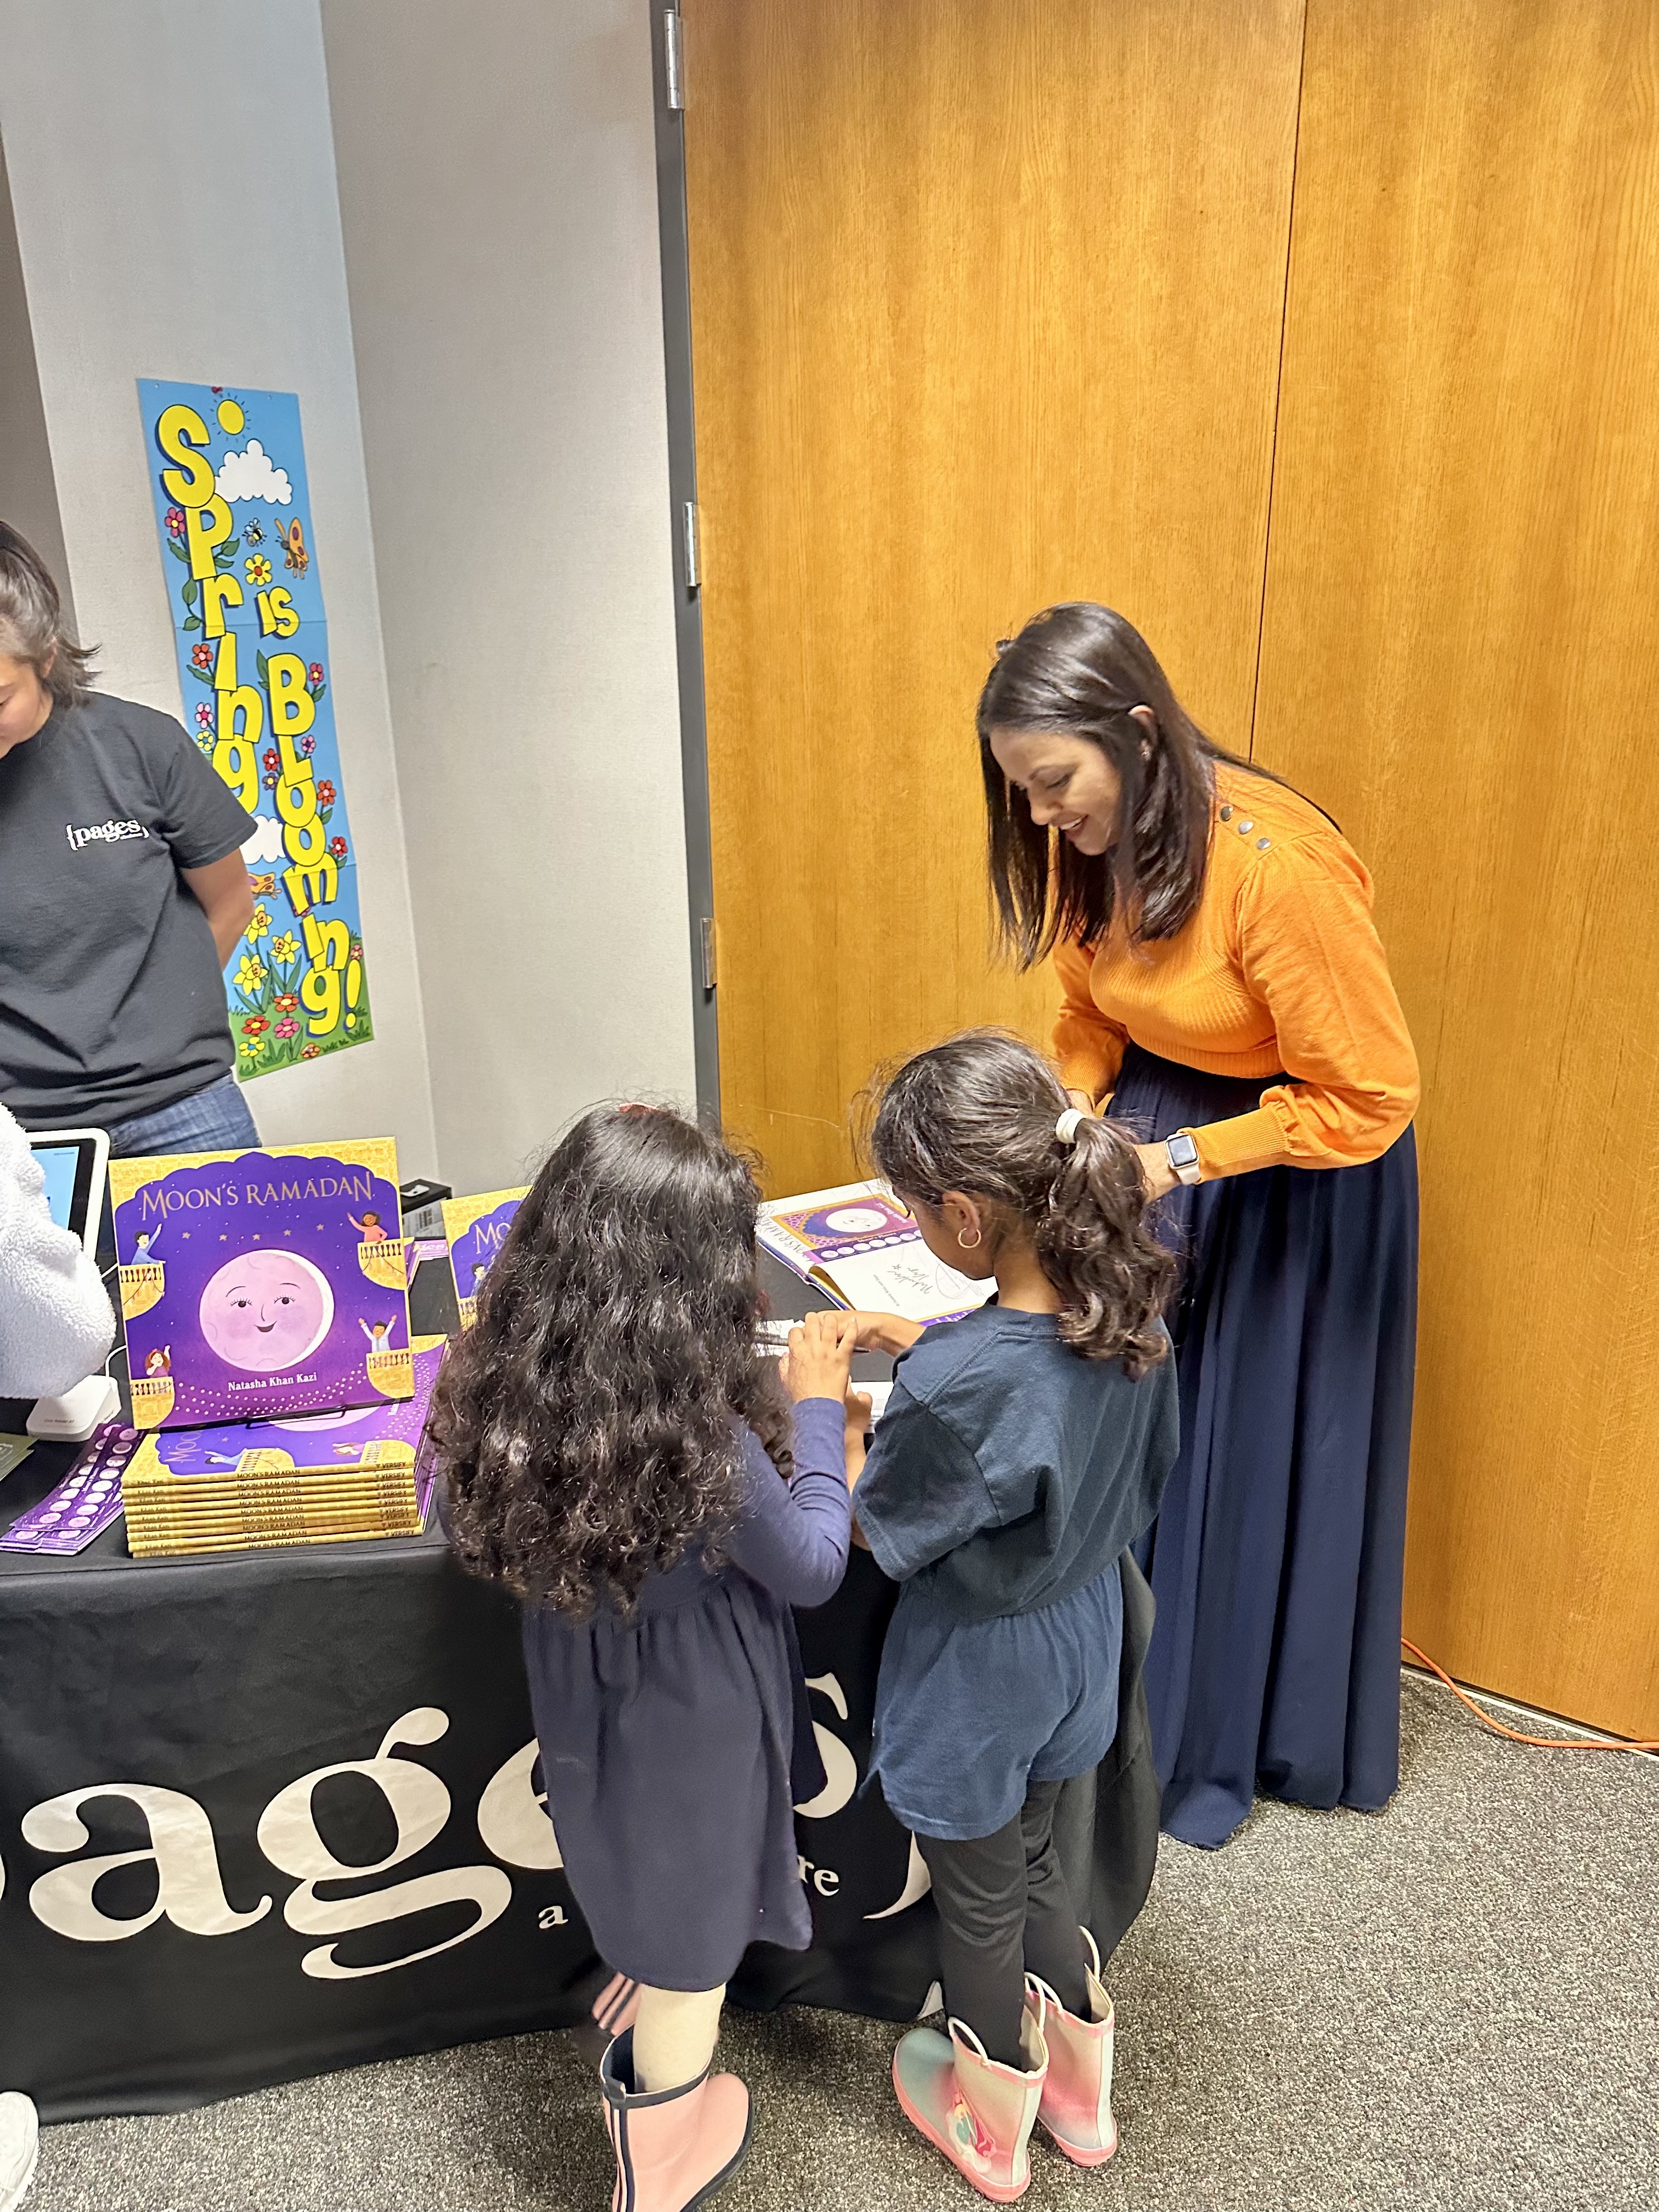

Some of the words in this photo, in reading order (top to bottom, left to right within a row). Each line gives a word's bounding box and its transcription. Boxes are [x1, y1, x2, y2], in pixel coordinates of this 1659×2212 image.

[141, 1183, 239, 1221] MOON'S
[246, 1171, 373, 1206] RAMADAN
[228, 1379, 267, 1391] Natasha
[269, 1376, 294, 1387] Khan
[296, 1372, 317, 1383] Kazi
